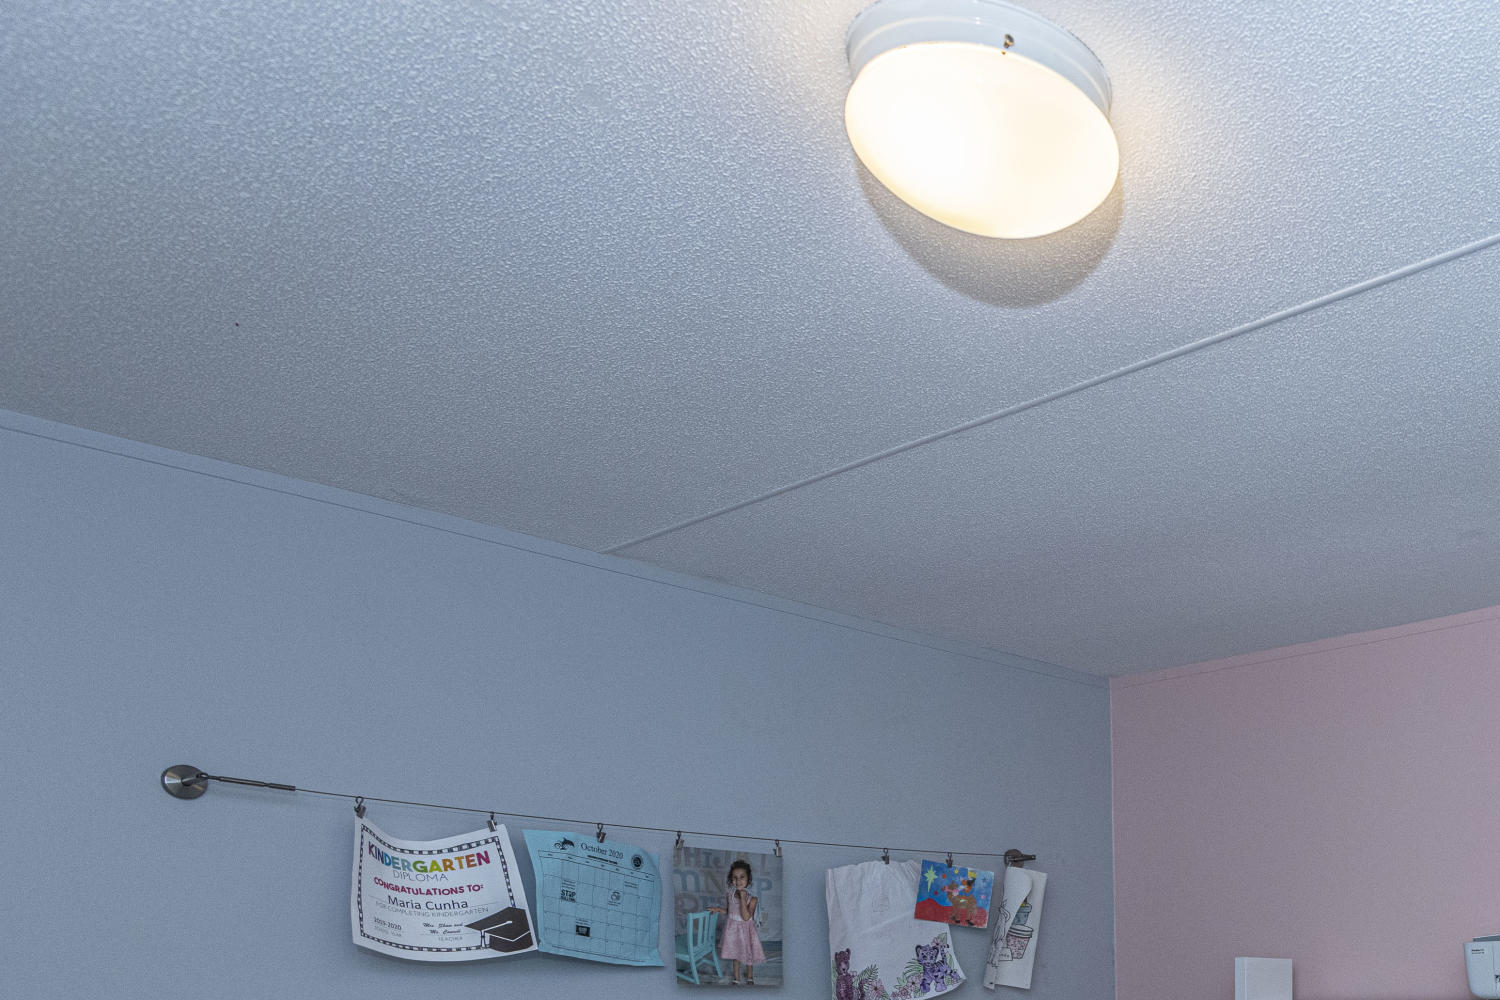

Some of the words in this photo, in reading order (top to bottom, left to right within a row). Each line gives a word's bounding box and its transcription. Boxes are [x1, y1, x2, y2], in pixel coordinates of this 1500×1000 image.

[580, 842, 607, 856] October
[368, 841, 491, 873] KINDERGARTEN
[393, 870, 449, 882] DIPLOMA
[373, 877, 466, 897] CONGRATULATIONS
[387, 895, 422, 910] Maria
[425, 899, 469, 911] Cunha
[387, 905, 430, 918] COMPLETING
[431, 907, 490, 918] KINDERGARTEN
